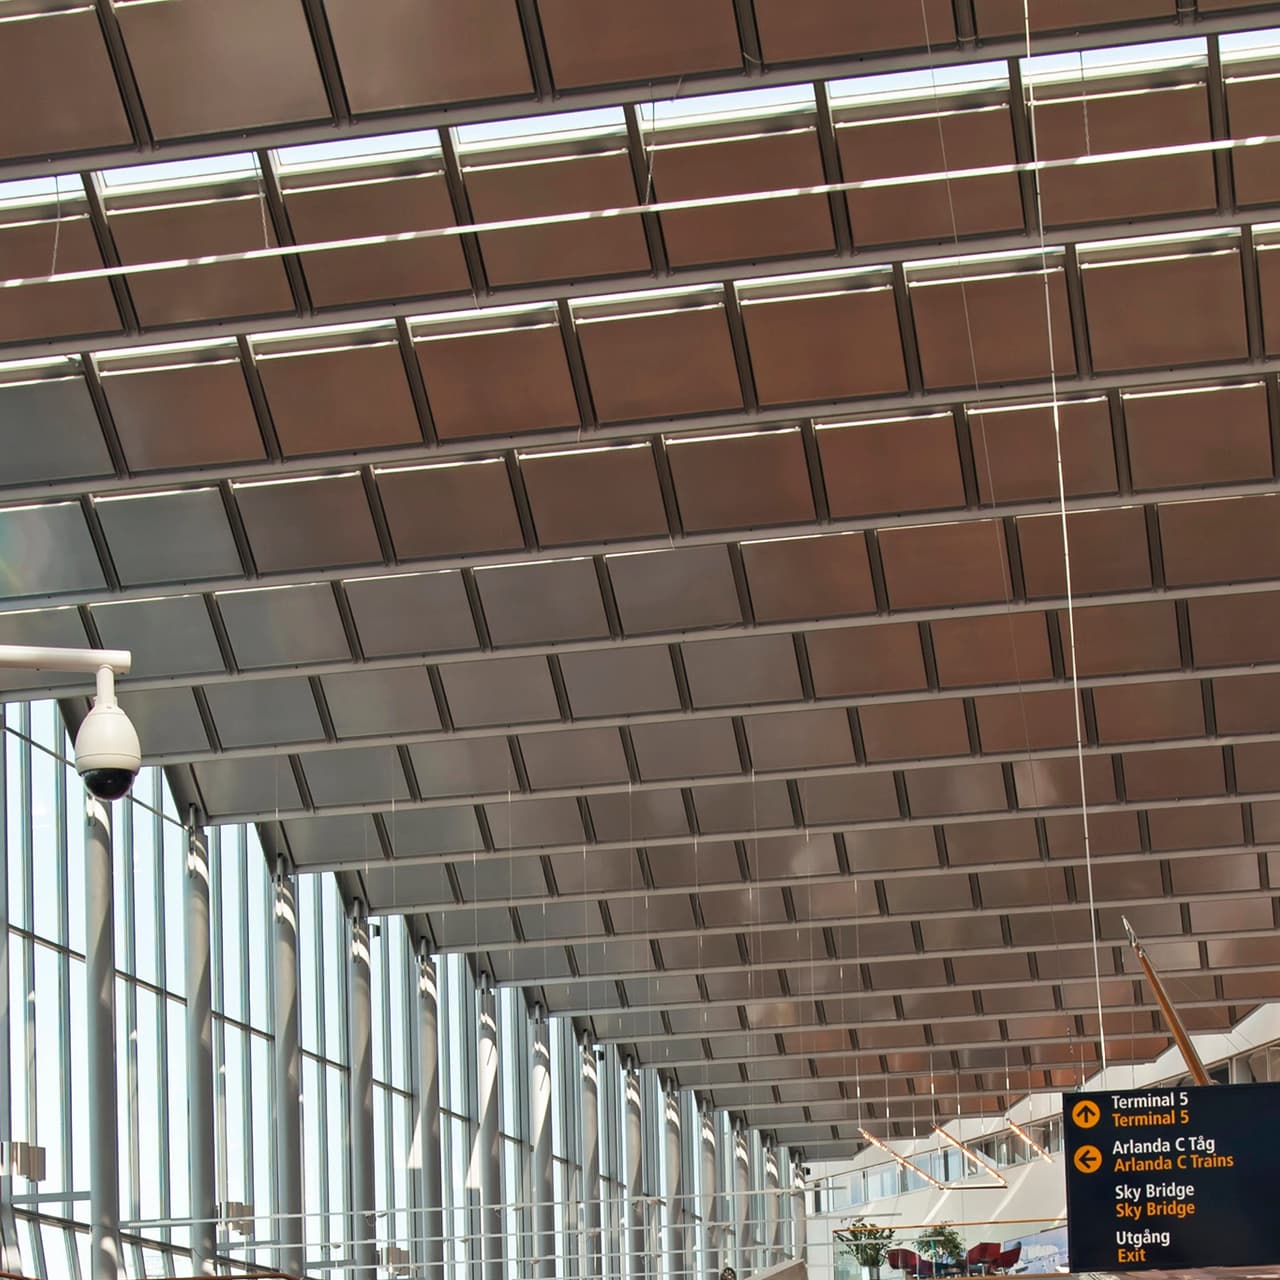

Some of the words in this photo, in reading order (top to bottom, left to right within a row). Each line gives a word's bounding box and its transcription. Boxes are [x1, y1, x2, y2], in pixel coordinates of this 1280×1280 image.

[1111, 1092, 1175, 1109] Terminal
[1179, 1091, 1189, 1106] 5
[1112, 1110, 1176, 1127] Terminal
[1180, 1109, 1190, 1124] 5
[1112, 1138, 1171, 1155] Arlanda
[1175, 1137, 1186, 1151] C
[1188, 1135, 1216, 1154] Tåg
[1113, 1156, 1173, 1173] Arlanda
[1177, 1155, 1187, 1169] C
[1190, 1153, 1235, 1169] Trains
[1115, 1184, 1142, 1202] Sky
[1146, 1182, 1195, 1201] Bridge
[1115, 1202, 1142, 1221] Sky
[1146, 1200, 1196, 1219] Bridge
[1116, 1229, 1171, 1248] Utgång
[1118, 1249, 1147, 1263] Exit
